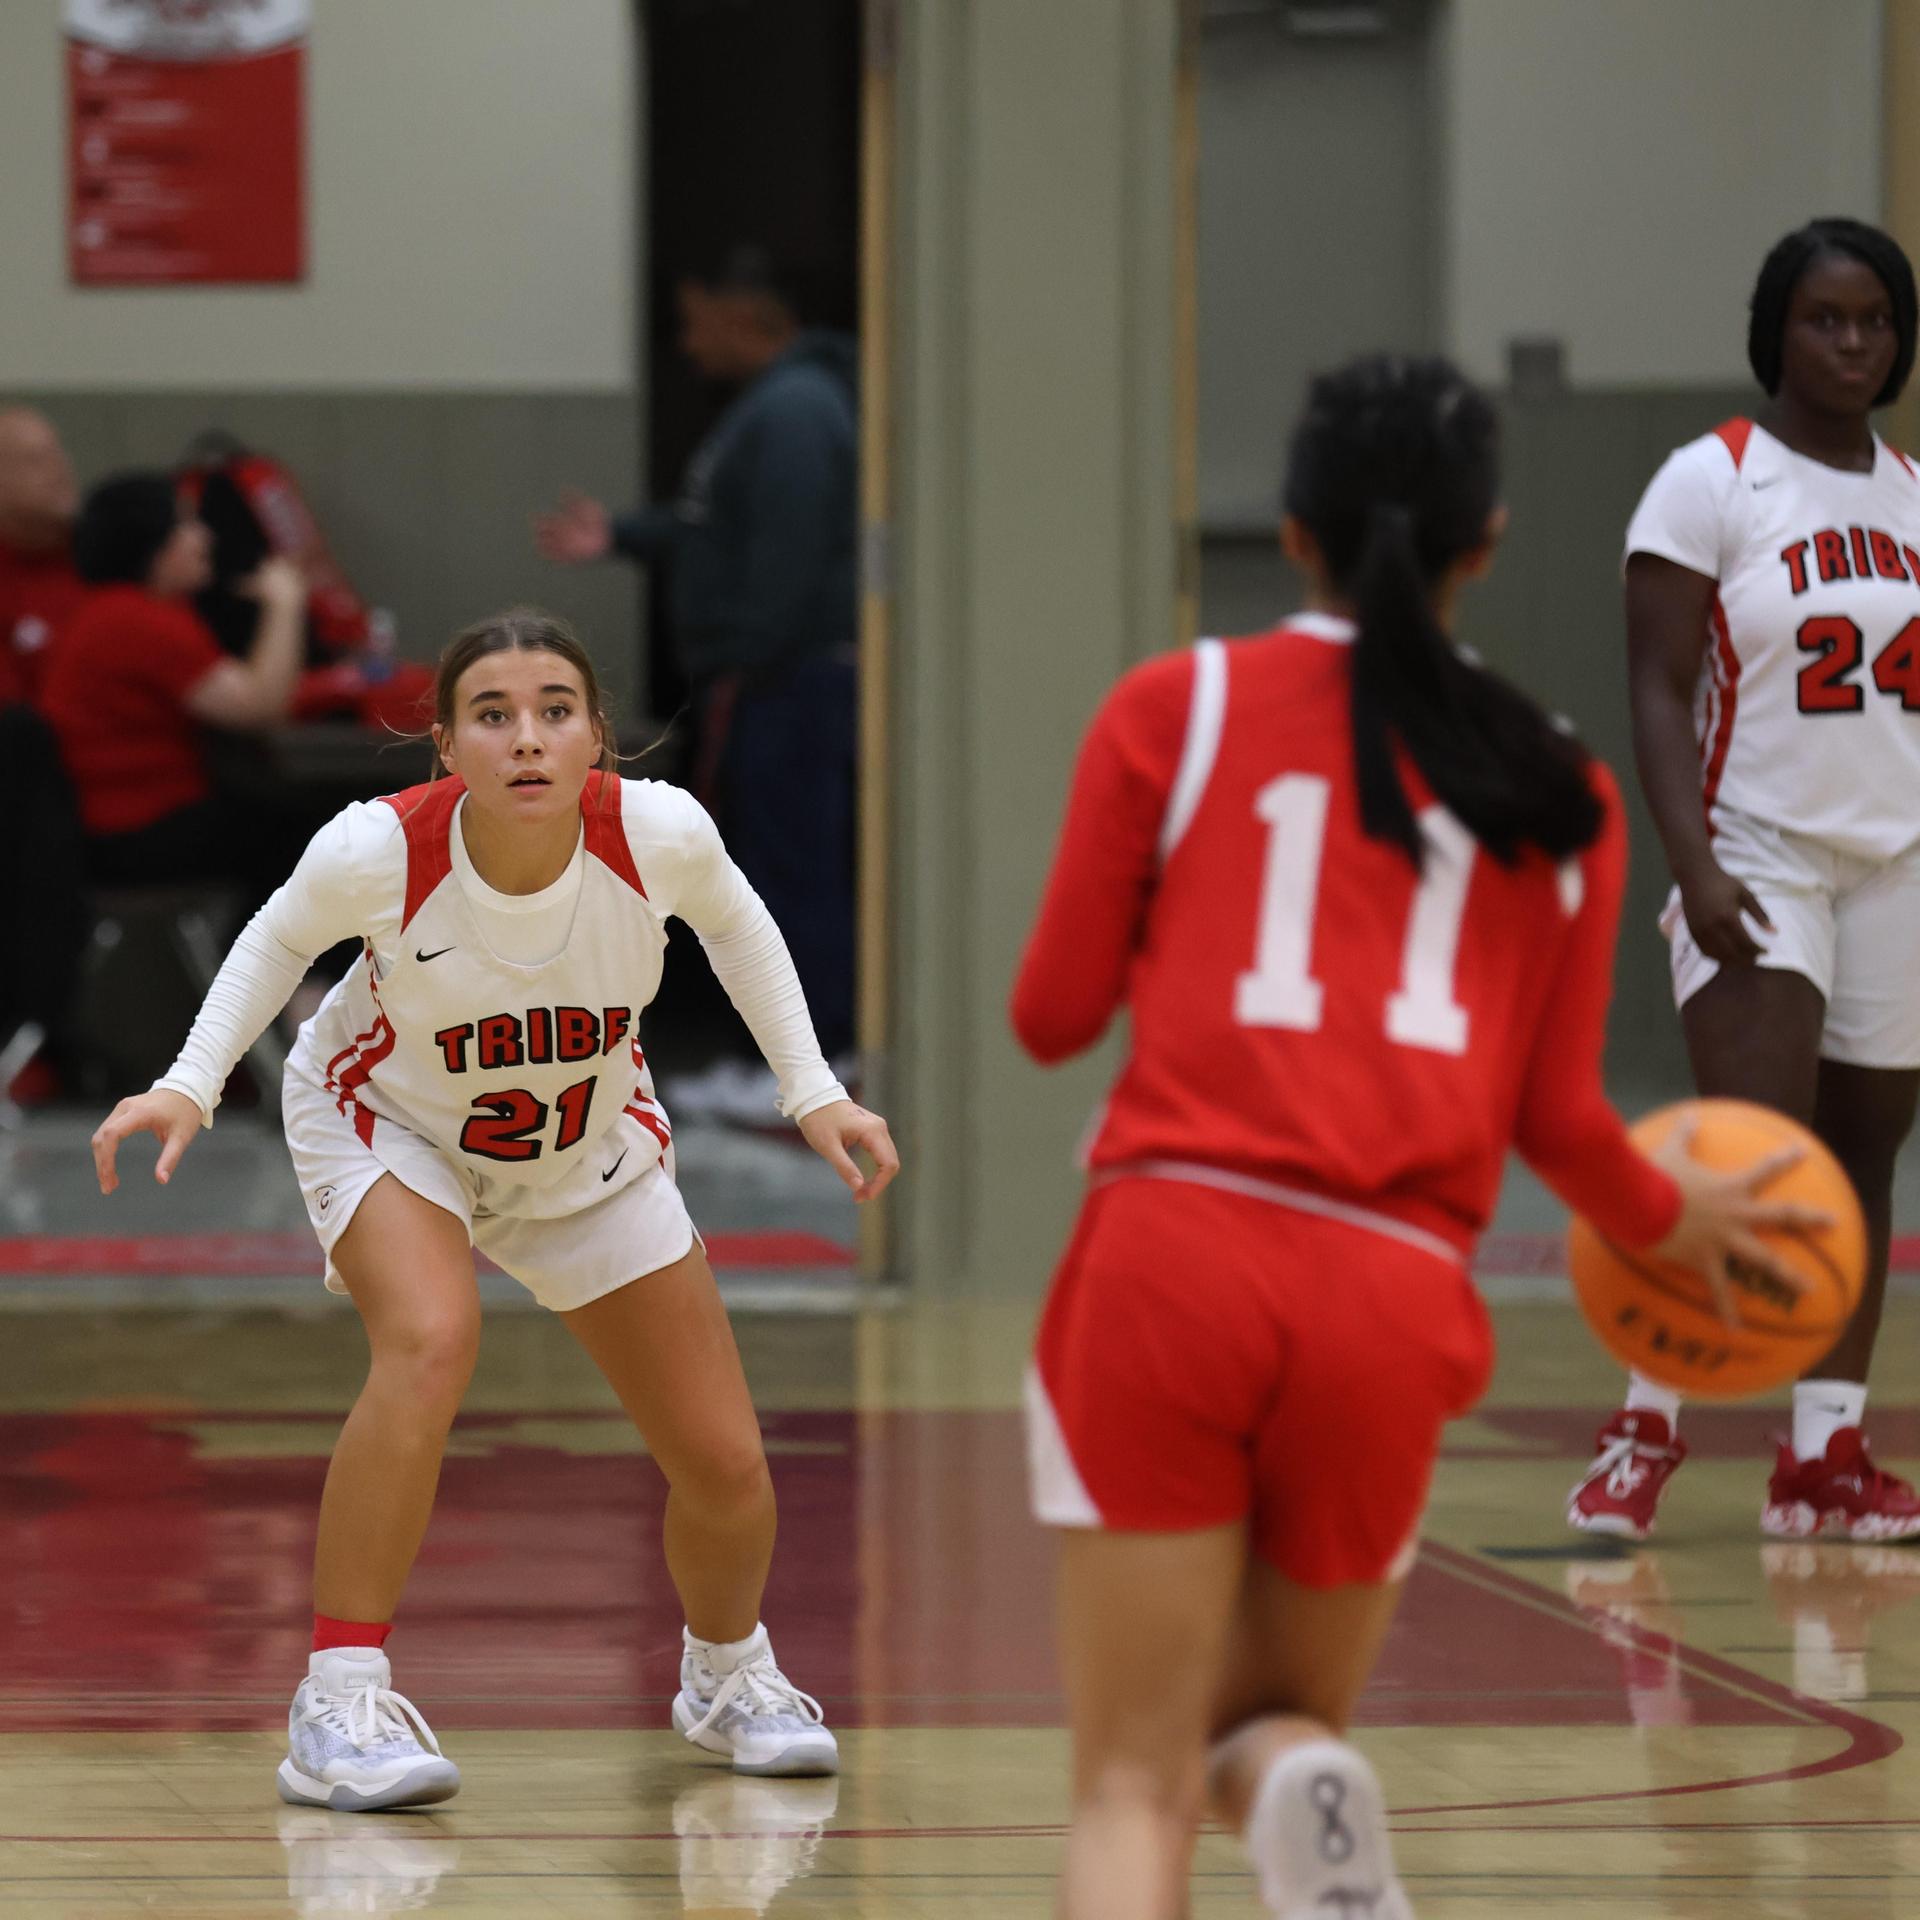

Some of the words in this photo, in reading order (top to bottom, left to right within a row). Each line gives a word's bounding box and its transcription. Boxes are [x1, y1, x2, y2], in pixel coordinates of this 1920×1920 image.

[1781, 525, 1920, 596] TRIB
[1797, 614, 1920, 714] 24
[1234, 772, 1478, 1057] 11
[459, 1075, 598, 1162] 21
